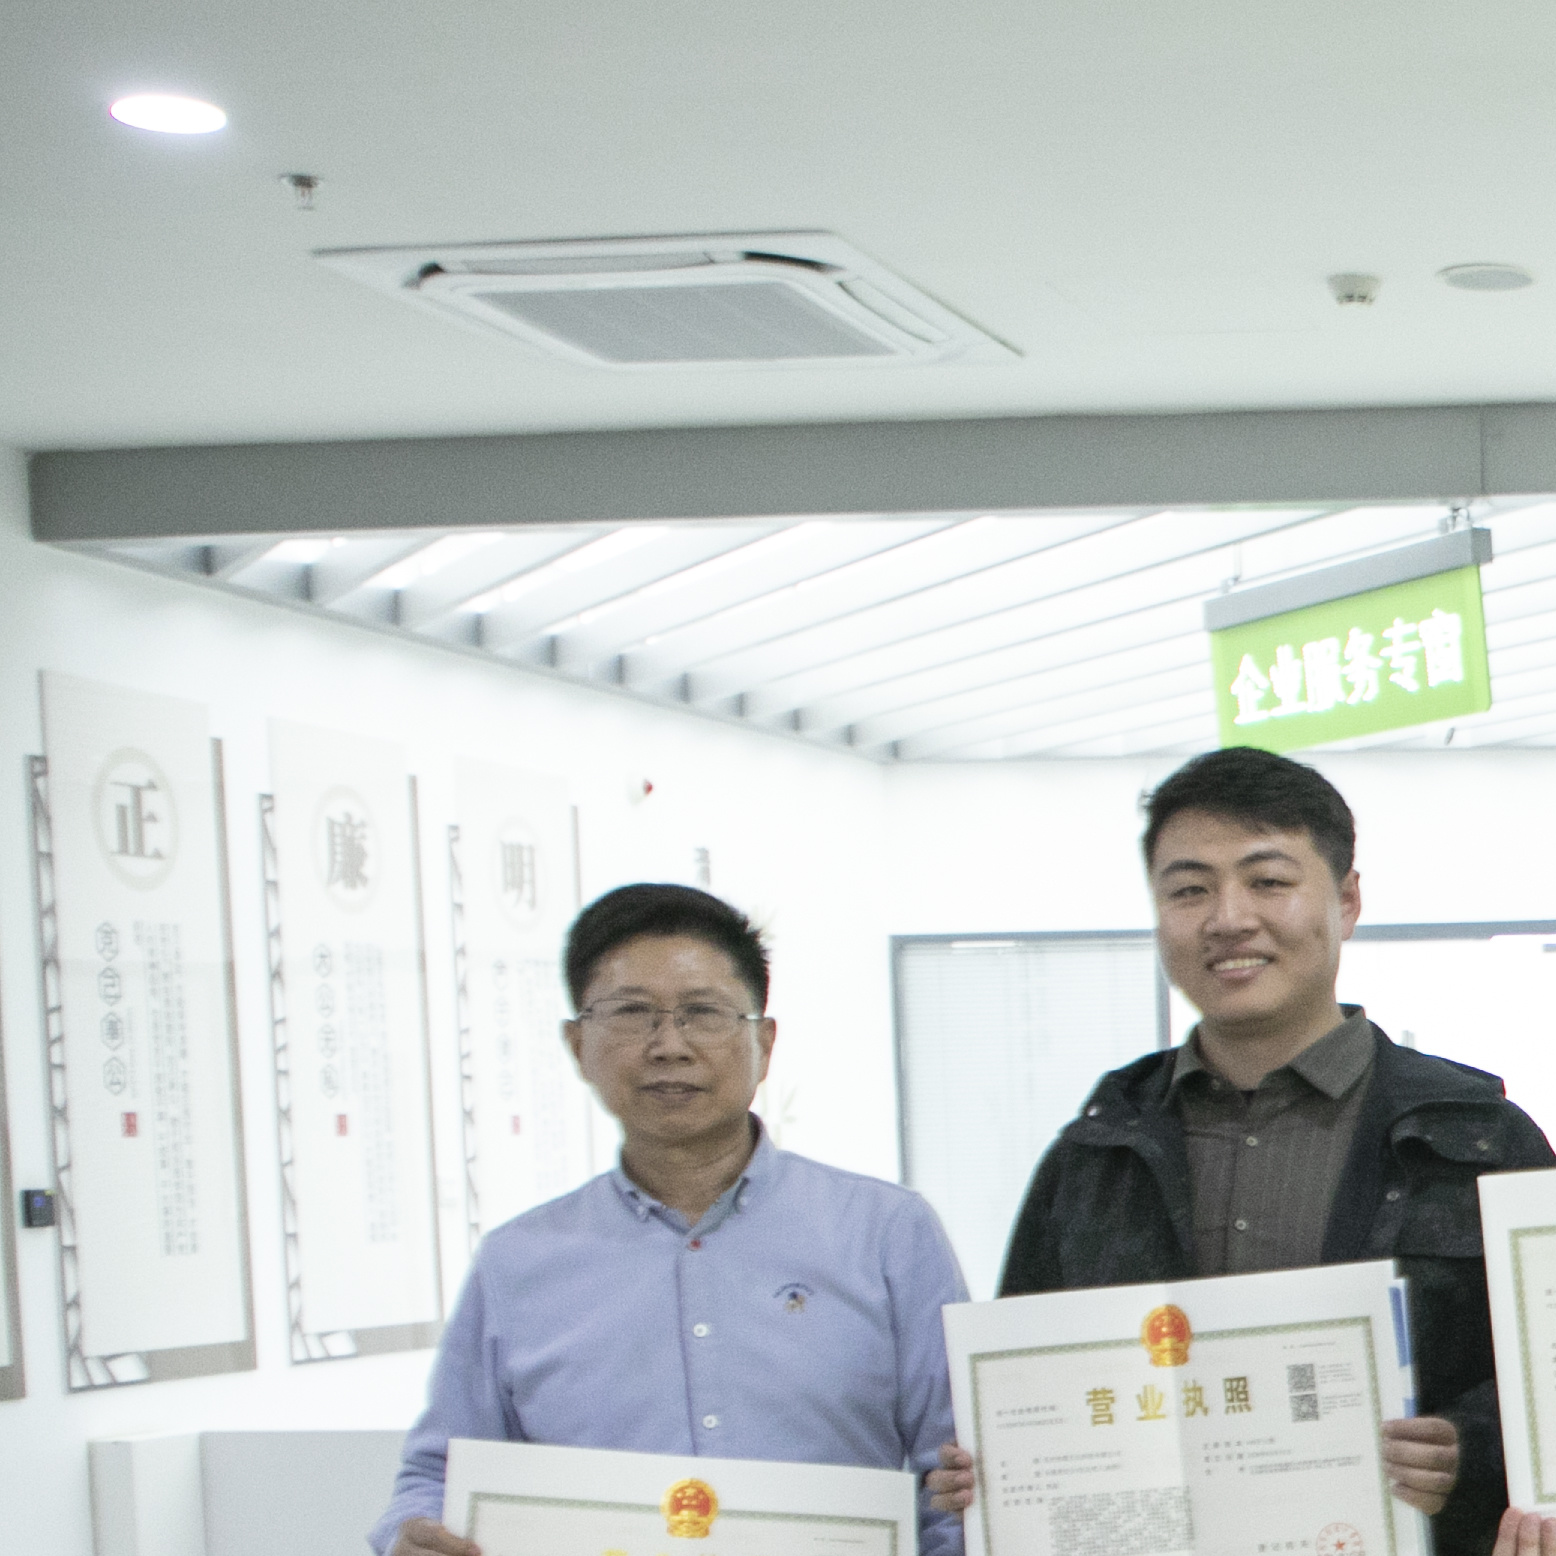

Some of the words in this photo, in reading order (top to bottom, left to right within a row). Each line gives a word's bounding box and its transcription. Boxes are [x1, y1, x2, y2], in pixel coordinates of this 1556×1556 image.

[1231, 609, 1463, 725] 企业服务专窗
[109, 779, 166, 862] 正
[326, 811, 369, 893] 廉
[501, 840, 537, 911] 明
[1087, 1375, 1251, 1425] 营业执照
